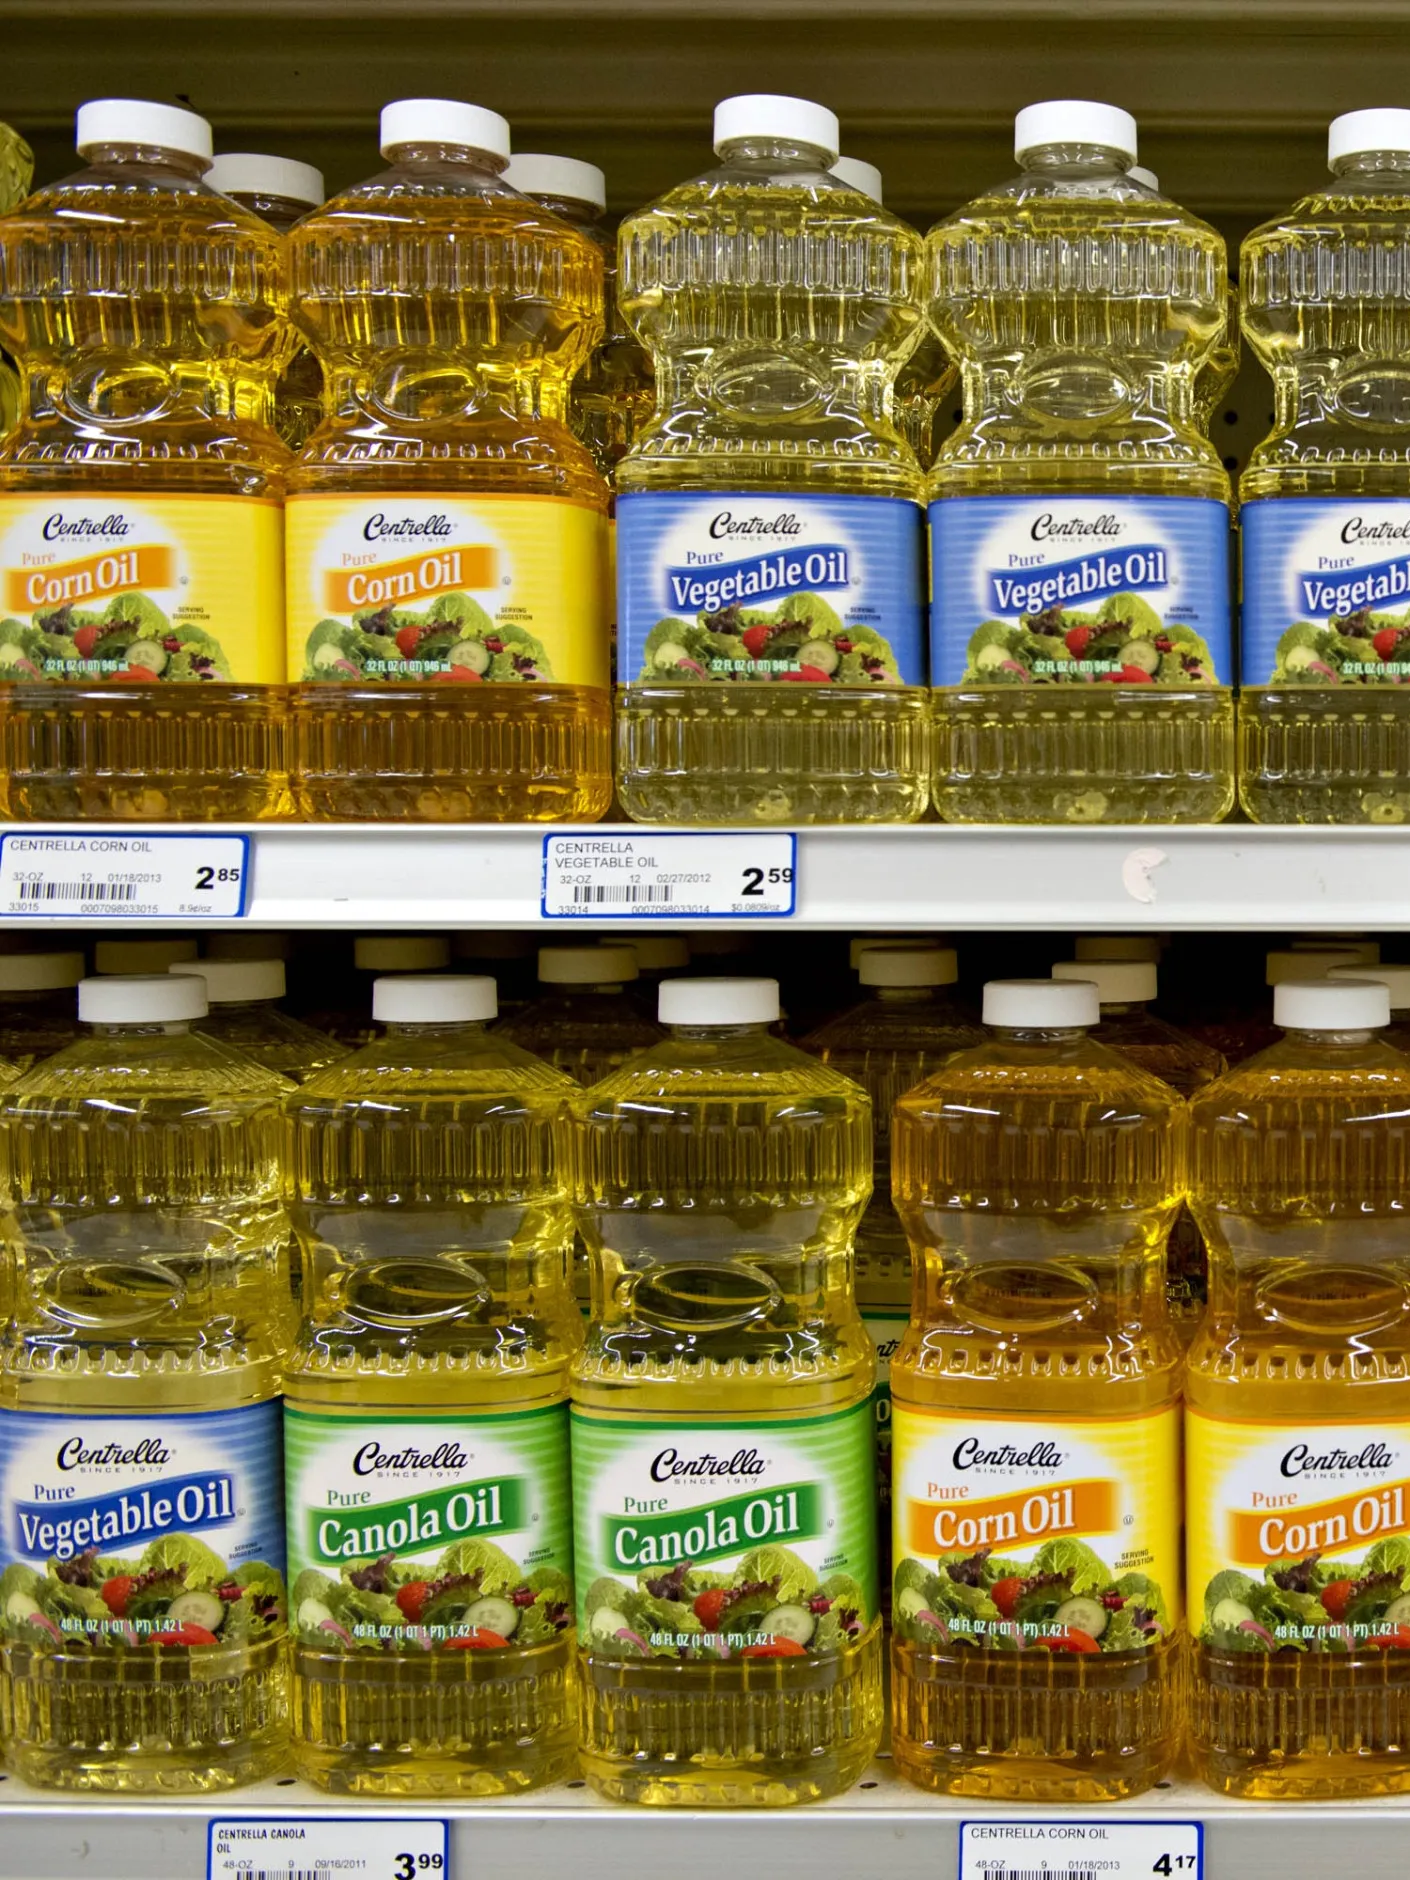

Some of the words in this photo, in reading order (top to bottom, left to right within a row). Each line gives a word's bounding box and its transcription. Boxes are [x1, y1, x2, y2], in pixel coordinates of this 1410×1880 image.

[43, 513, 129, 541] Centrella
[364, 513, 451, 541] Centrella
[709, 511, 802, 539] Centrella
[1031, 513, 1122, 541] Centrella
[22, 552, 55, 566] Pure
[342, 552, 377, 566] Pure
[687, 551, 723, 564] Pure
[1008, 553, 1045, 567] Pure
[1318, 556, 1354, 569] Pure
[27, 570, 93, 605] Corn
[97, 552, 139, 589] Oil
[348, 570, 416, 605] Corn
[419, 552, 463, 590] Oil
[671, 557, 801, 611] Vegetable
[805, 551, 849, 585] Oil
[993, 559, 1122, 614] Vegetable
[1125, 551, 1169, 585] Oil
[10, 840, 86, 852] CENTRELLA
[90, 841, 128, 852] CORN
[131, 841, 152, 852] OIL
[555, 842, 634, 854] CENTRELLA
[555, 857, 633, 869] VEGETABLE
[637, 857, 659, 868] OIL
[13, 872, 44, 882] 32-OZ
[81, 873, 92, 882] 12
[107, 873, 162, 883] 01/18/2013
[560, 875, 592, 884] 32-OZ
[629, 875, 641, 884] 12
[656, 873, 712, 884] 02/27/2012
[8, 903, 39, 912] 33015
[57, 1437, 170, 1472] Centrella
[353, 1442, 468, 1477] Centrella
[952, 1437, 1063, 1470] Centrella
[1280, 1443, 1393, 1478] Centrella
[650, 1448, 765, 1483] Centrella
[34, 1484, 75, 1501] Pure
[327, 1489, 371, 1506] Pure
[927, 1482, 969, 1500] Pure
[1252, 1491, 1297, 1508] Pure
[624, 1497, 668, 1513] Pure
[19, 1492, 172, 1559] Vegetable
[177, 1478, 235, 1523] Oil
[319, 1502, 441, 1558] Canola
[446, 1485, 502, 1531] Oil
[933, 1510, 1018, 1548] Corn
[1022, 1489, 1075, 1535] Oil
[1259, 1514, 1348, 1556] Corn
[1352, 1487, 1405, 1536] Oil
[615, 1510, 739, 1565] Canola
[743, 1492, 800, 1538] Oil
[1114, 1556, 1154, 1569] SUGGESTION
[1121, 1549, 1149, 1560] SERVING
[650, 1633, 662, 1645] 48
[664, 1633, 674, 1645] FL
[676, 1633, 689, 1646] OZ
[703, 1633, 717, 1647] QT
[747, 1633, 768, 1646] 1.42
[218, 1829, 267, 1840] CENTRELLA
[271, 1828, 306, 1839] CANOLA
[971, 1828, 1045, 1839] CENTRELLA
[1049, 1828, 1085, 1839] CORN
[1089, 1829, 1109, 1840] OIL
[216, 1843, 232, 1854] OIL
[222, 1860, 253, 1869] 48-OZ
[315, 1859, 366, 1869] 09/16/2011
[975, 1860, 1006, 1870] 48-OZ
[1068, 1860, 1121, 1870] 01/18/2013
